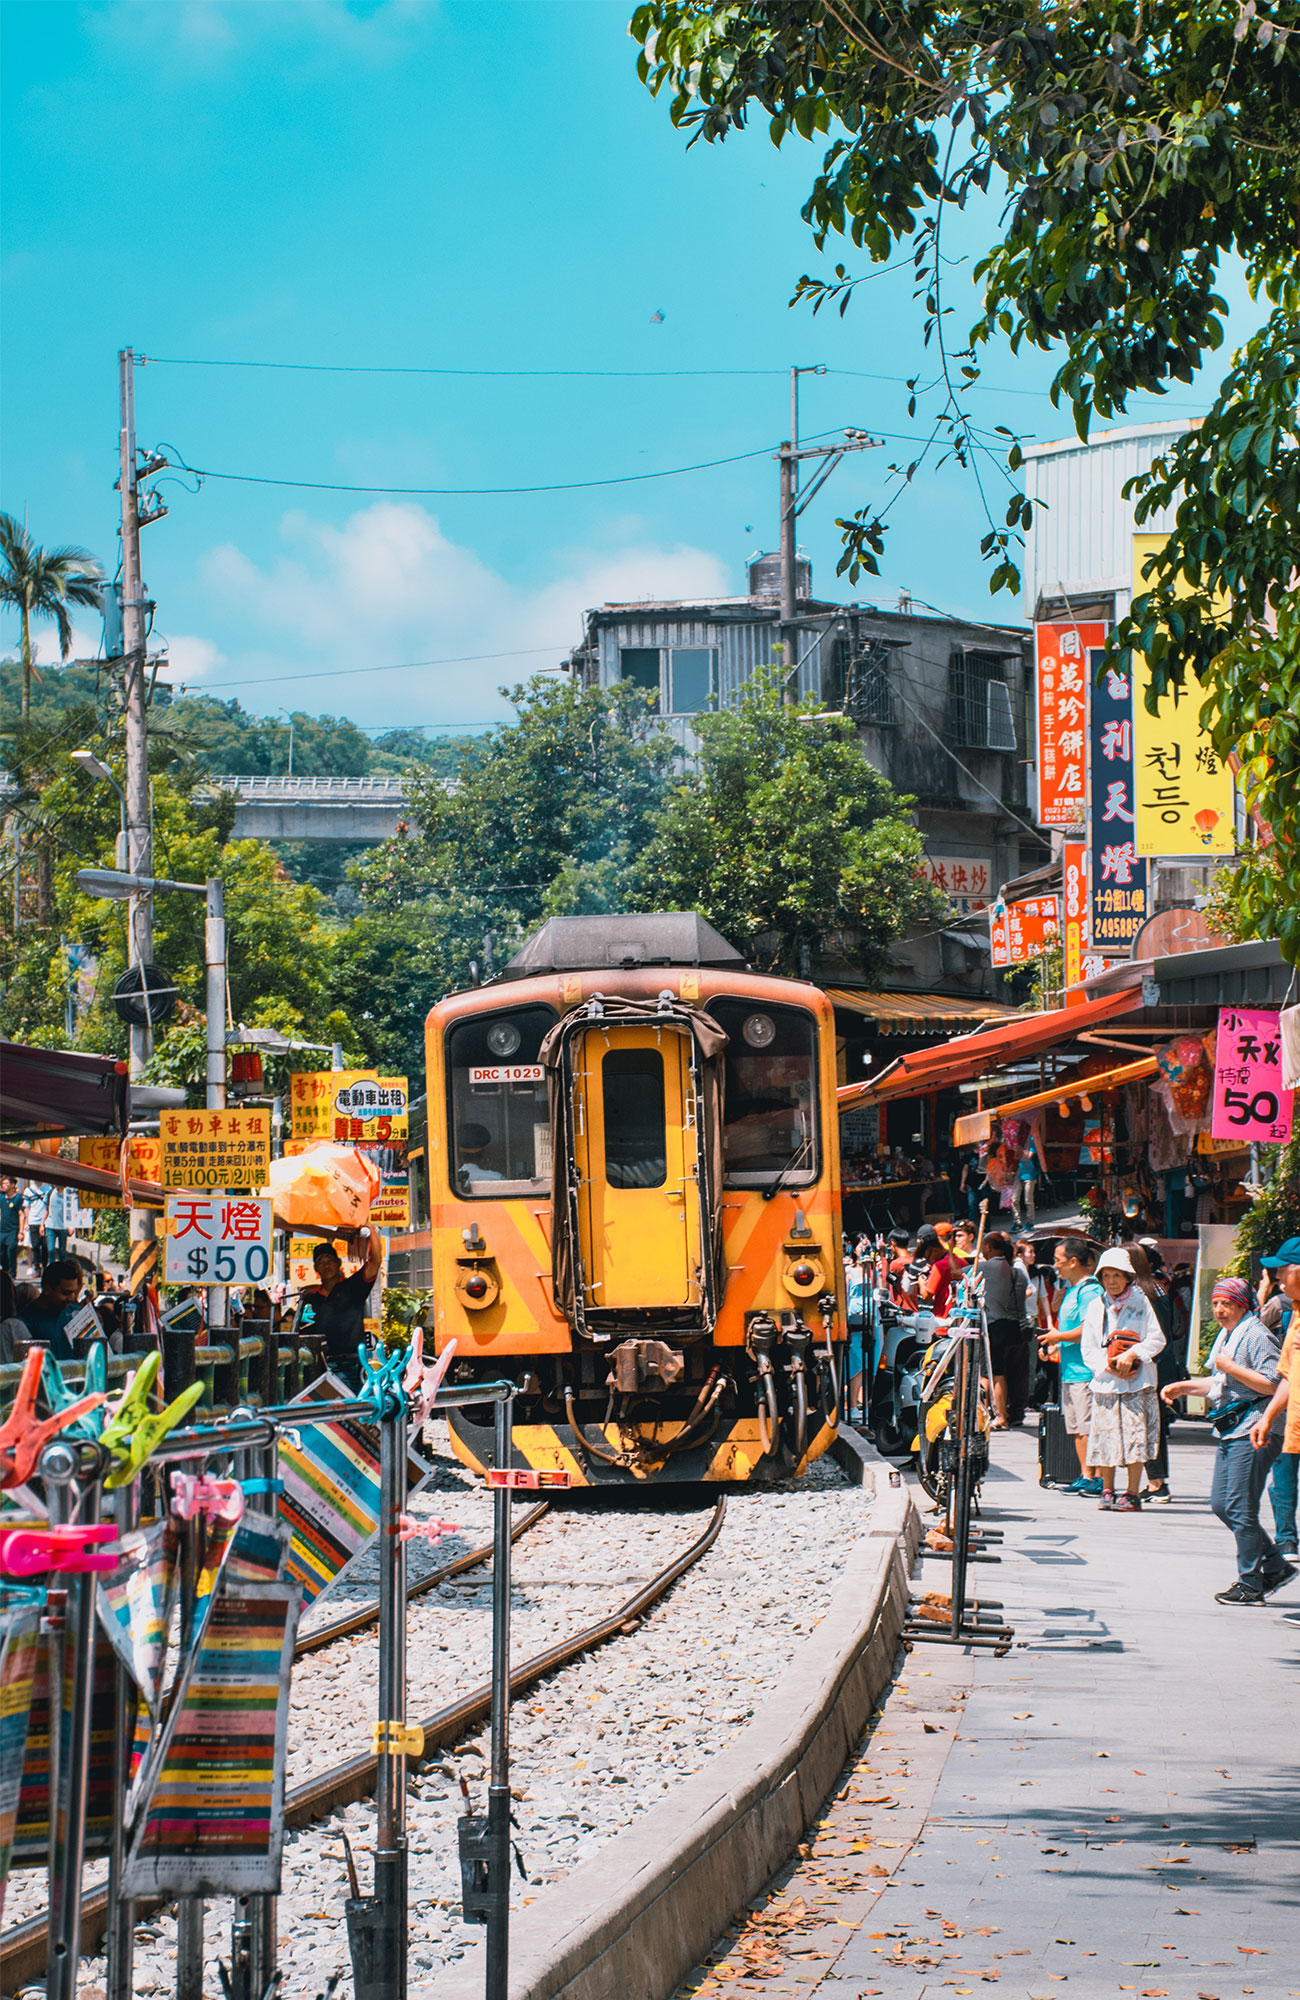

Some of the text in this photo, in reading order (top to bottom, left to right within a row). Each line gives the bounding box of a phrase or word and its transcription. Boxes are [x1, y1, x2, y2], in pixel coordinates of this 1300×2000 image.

[1223, 1014, 1243, 1031] 小
[474, 1067, 541, 1080] DRC 1029
[338, 1089, 402, 1106] 電動車出租
[1224, 1087, 1279, 1125] 50
[165, 1114, 264, 1137] 電動車出租
[173, 1201, 262, 1241] 天燈
[187, 1245, 270, 1283] $50
